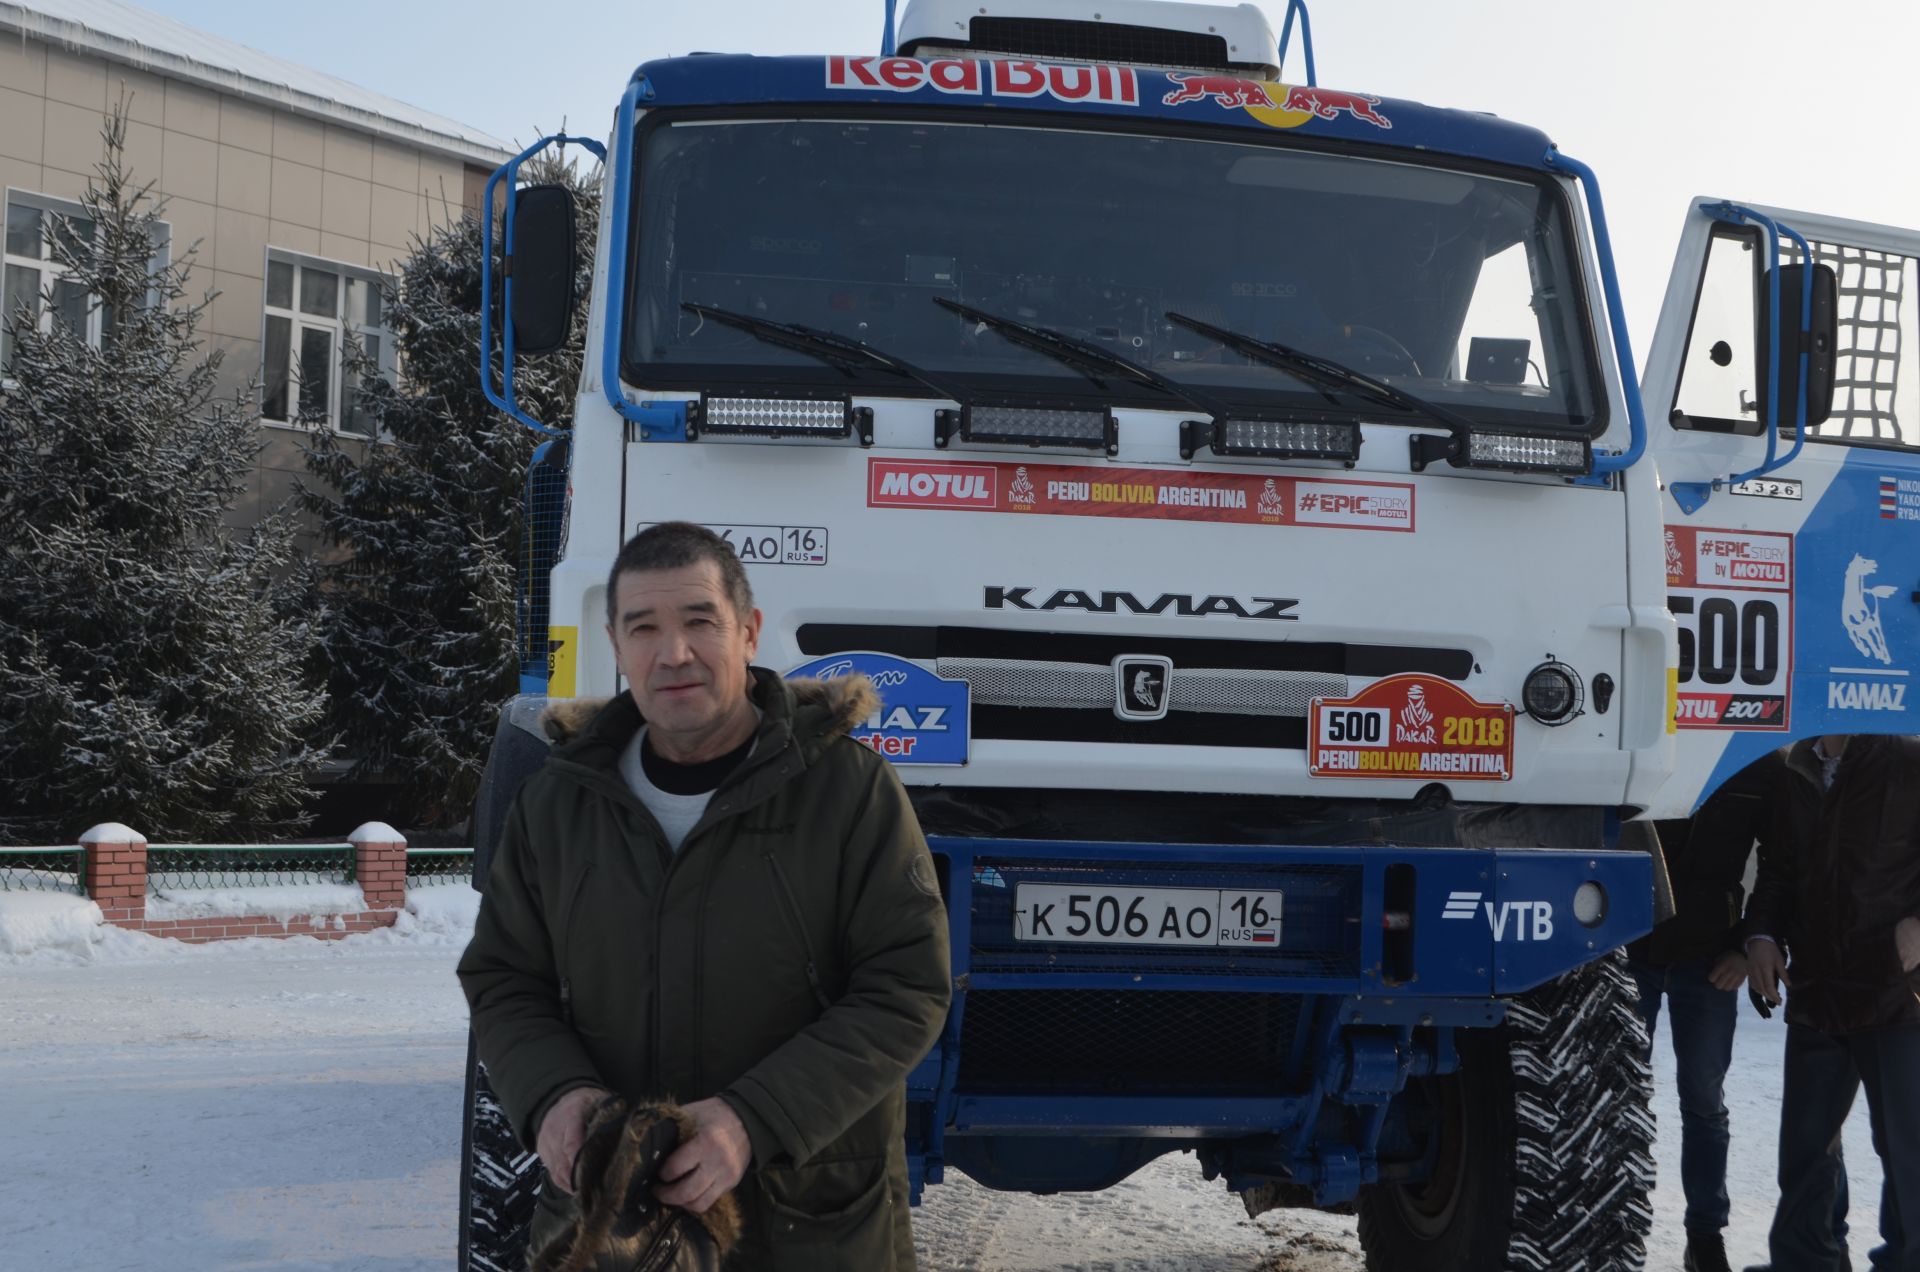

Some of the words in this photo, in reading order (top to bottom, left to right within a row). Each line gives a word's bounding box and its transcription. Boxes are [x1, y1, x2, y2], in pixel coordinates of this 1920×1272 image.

[829, 55, 979, 92] Red
[994, 59, 1136, 102] Bull
[879, 472, 989, 499] MOTUL
[1008, 490, 1037, 504] DAKAR
[1047, 481, 1090, 502] PERU
[1091, 483, 1156, 505] BOLIVIA
[1157, 486, 1247, 509] ARGENTINA
[1739, 481, 1794, 496] 4326
[1257, 502, 1285, 516] DAKAR
[1378, 510, 1407, 519] MOTUL
[787, 529, 817, 552] 16
[787, 552, 809, 561] RUS
[1715, 562, 1726, 577] by
[1732, 562, 1784, 579] MOTUL
[984, 586, 1300, 621] KAMAZ
[1667, 596, 1779, 686] 500
[1828, 681, 1905, 711] KAMAZ
[1725, 701, 1782, 719] 300V
[1328, 711, 1381, 742] 500
[1396, 724, 1437, 745] DAKAR
[1443, 717, 1505, 746] 2018
[1318, 750, 1360, 769] PERU
[1359, 752, 1420, 770] BOLIVIA
[1420, 753, 1505, 773] ARGENTINA
[1230, 896, 1269, 928] 16
[1484, 901, 1554, 942] VTB
[1221, 928, 1252, 942] RUS
